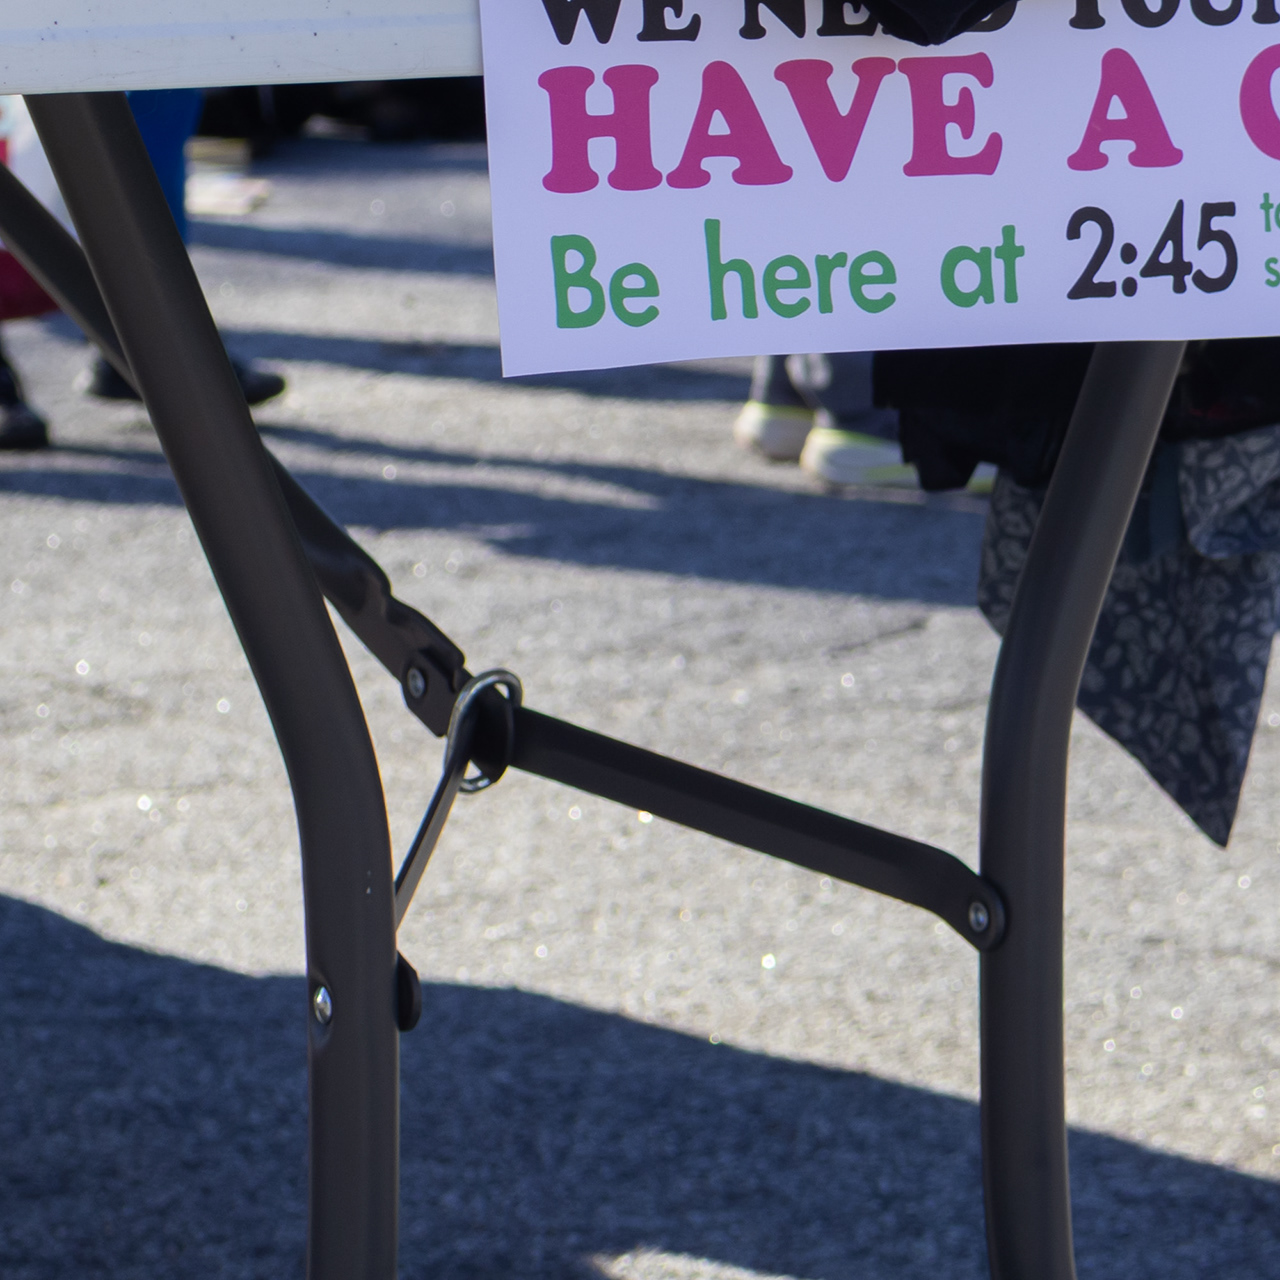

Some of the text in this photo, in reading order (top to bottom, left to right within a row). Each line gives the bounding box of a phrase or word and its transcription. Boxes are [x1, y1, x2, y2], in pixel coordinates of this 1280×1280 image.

[537, 52, 1003, 194] HAVE
[1066, 47, 1184, 171] A
[551, 200, 1238, 329] Be here at 2:45
